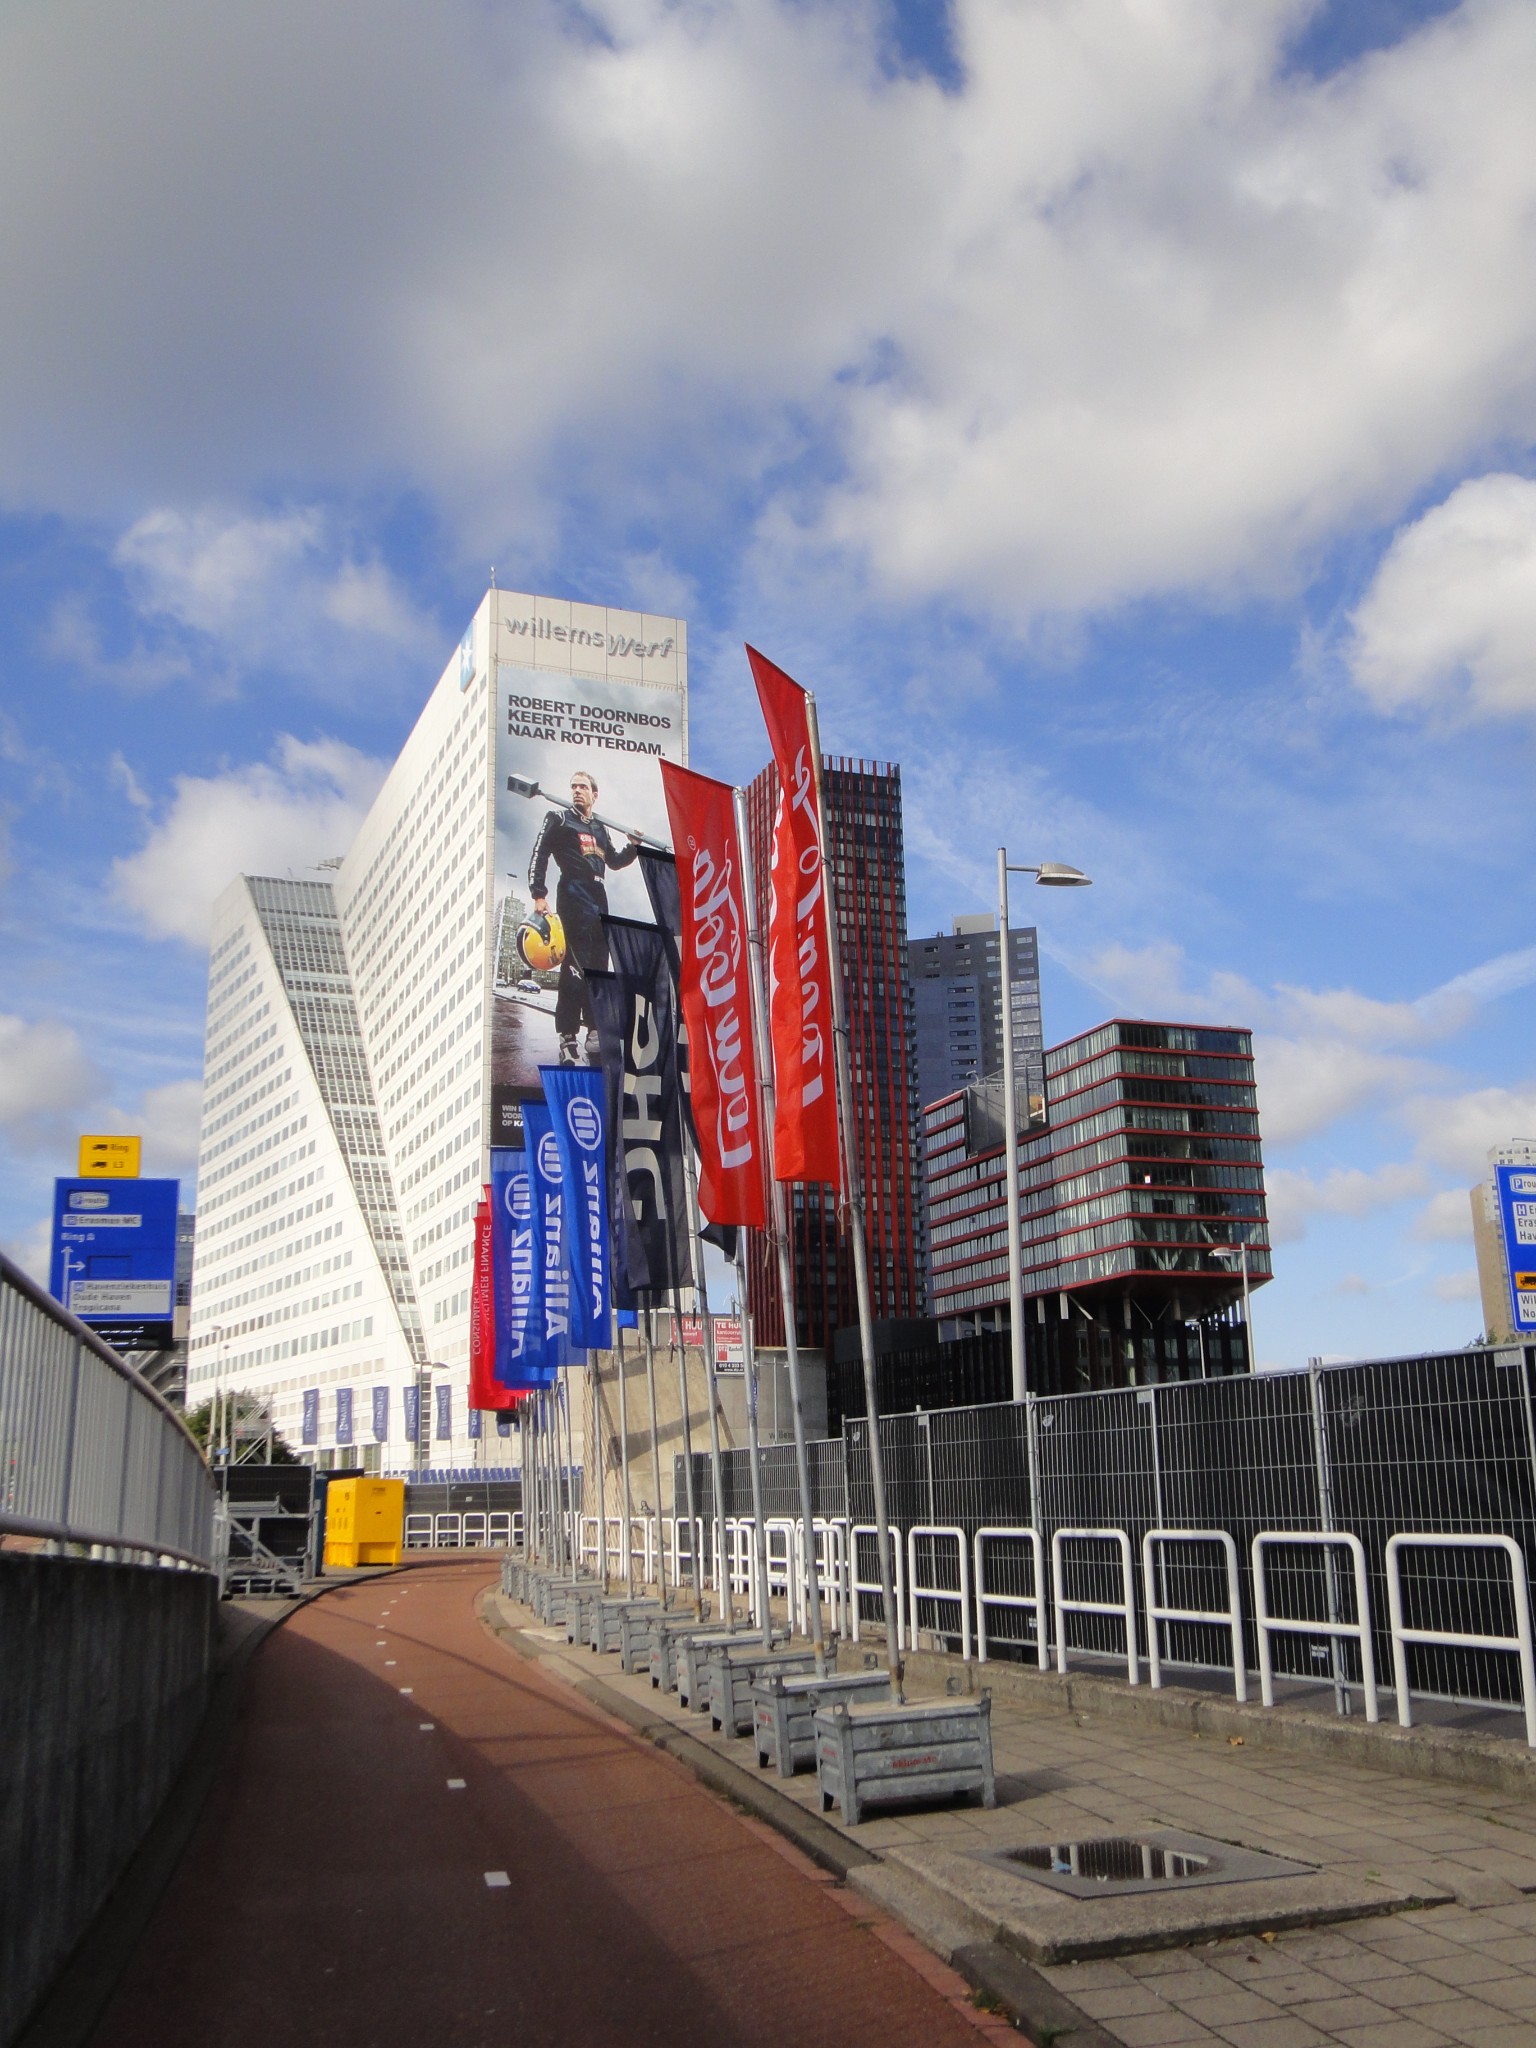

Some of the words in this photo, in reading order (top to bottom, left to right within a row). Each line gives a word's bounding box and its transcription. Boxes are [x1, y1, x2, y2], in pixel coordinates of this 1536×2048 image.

[508, 694, 576, 714] ROBERT
[580, 704, 672, 729] DOORNBOS
[508, 709, 562, 728] KEERT
[568, 717, 625, 736] TERUG
[507, 723, 556, 741] NAAR
[560, 730, 666, 757] ROTTERDAM.
[1515, 1179, 1522, 1189] P
[1518, 1205, 1526, 1215] H
[79, 1216, 120, 1225] Erasmus
[122, 1216, 138, 1225] MC
[73, 1293, 98, 1301] Oude
[101, 1293, 132, 1301] Haven
[73, 1303, 121, 1312] Tropicana
